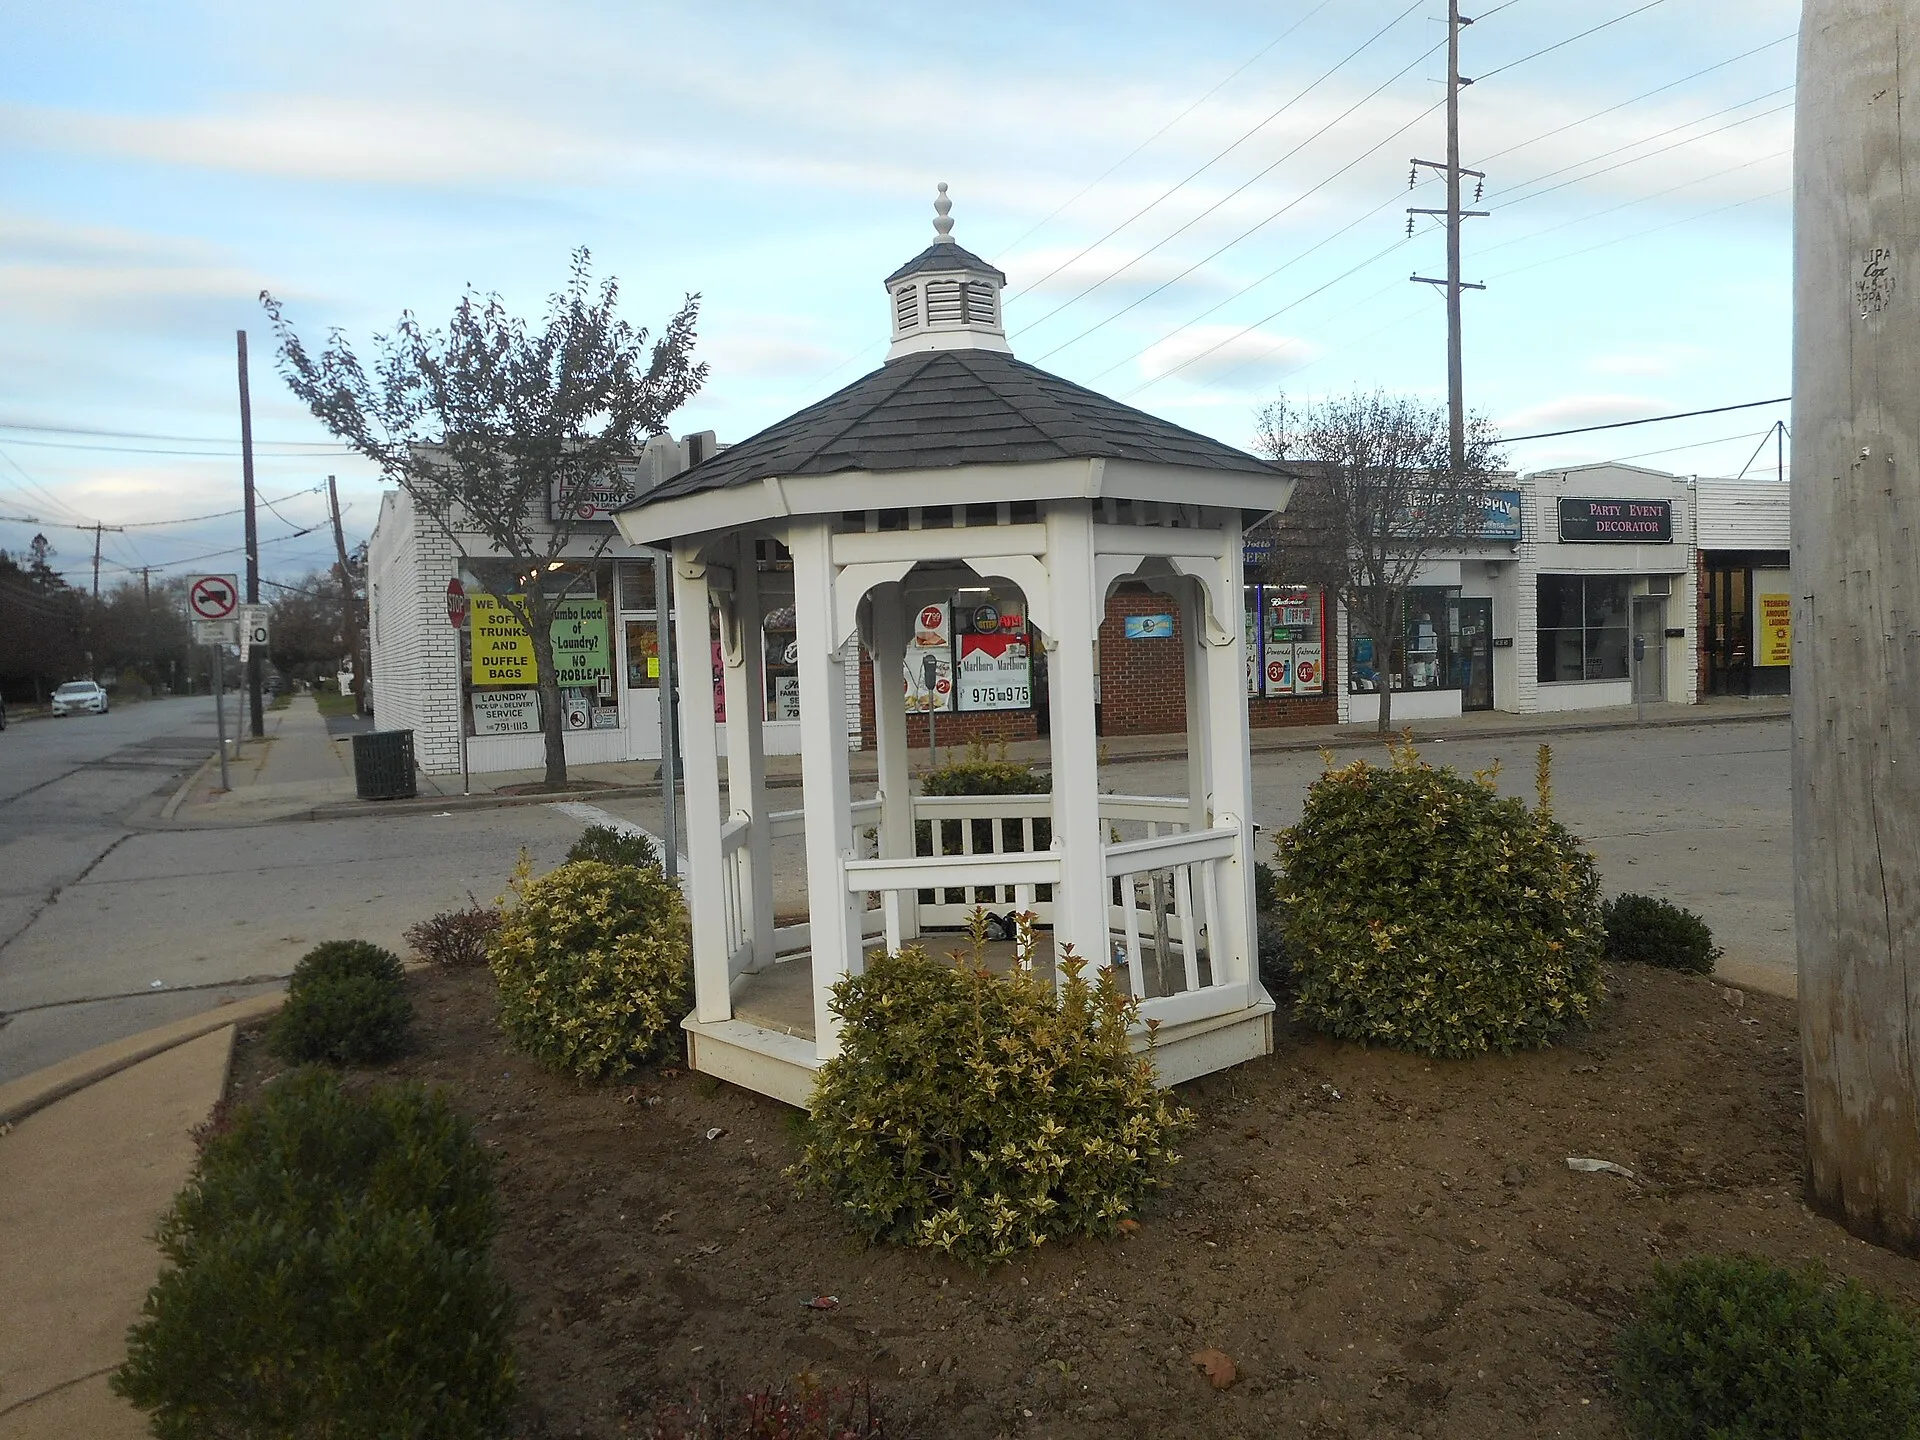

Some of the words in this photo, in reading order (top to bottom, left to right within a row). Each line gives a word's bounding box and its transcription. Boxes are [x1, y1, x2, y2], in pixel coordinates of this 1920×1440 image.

[1590, 503, 1621, 516] PARTY
[1629, 504, 1664, 517] EVENT
[1596, 521, 1659, 532] DECORATOR
[448, 594, 464, 612] STOP
[476, 600, 494, 609] WE
[553, 607, 578, 620] umbo
[580, 606, 602, 620] Load
[488, 615, 518, 624] SOFT
[479, 627, 529, 636] TRUNKS
[572, 621, 582, 634] of
[492, 641, 517, 650] AND
[557, 635, 599, 650] Laundry?
[482, 656, 528, 666] DUFFLE
[572, 655, 586, 667] NO
[963, 656, 994, 672] Marlboro
[998, 656, 1027, 671] Marlboro
[489, 669, 522, 678] BAGS
[481, 692, 527, 702] LAUNDRY
[504, 701, 534, 709] DELIVERY
[486, 709, 523, 718] SERVICE
